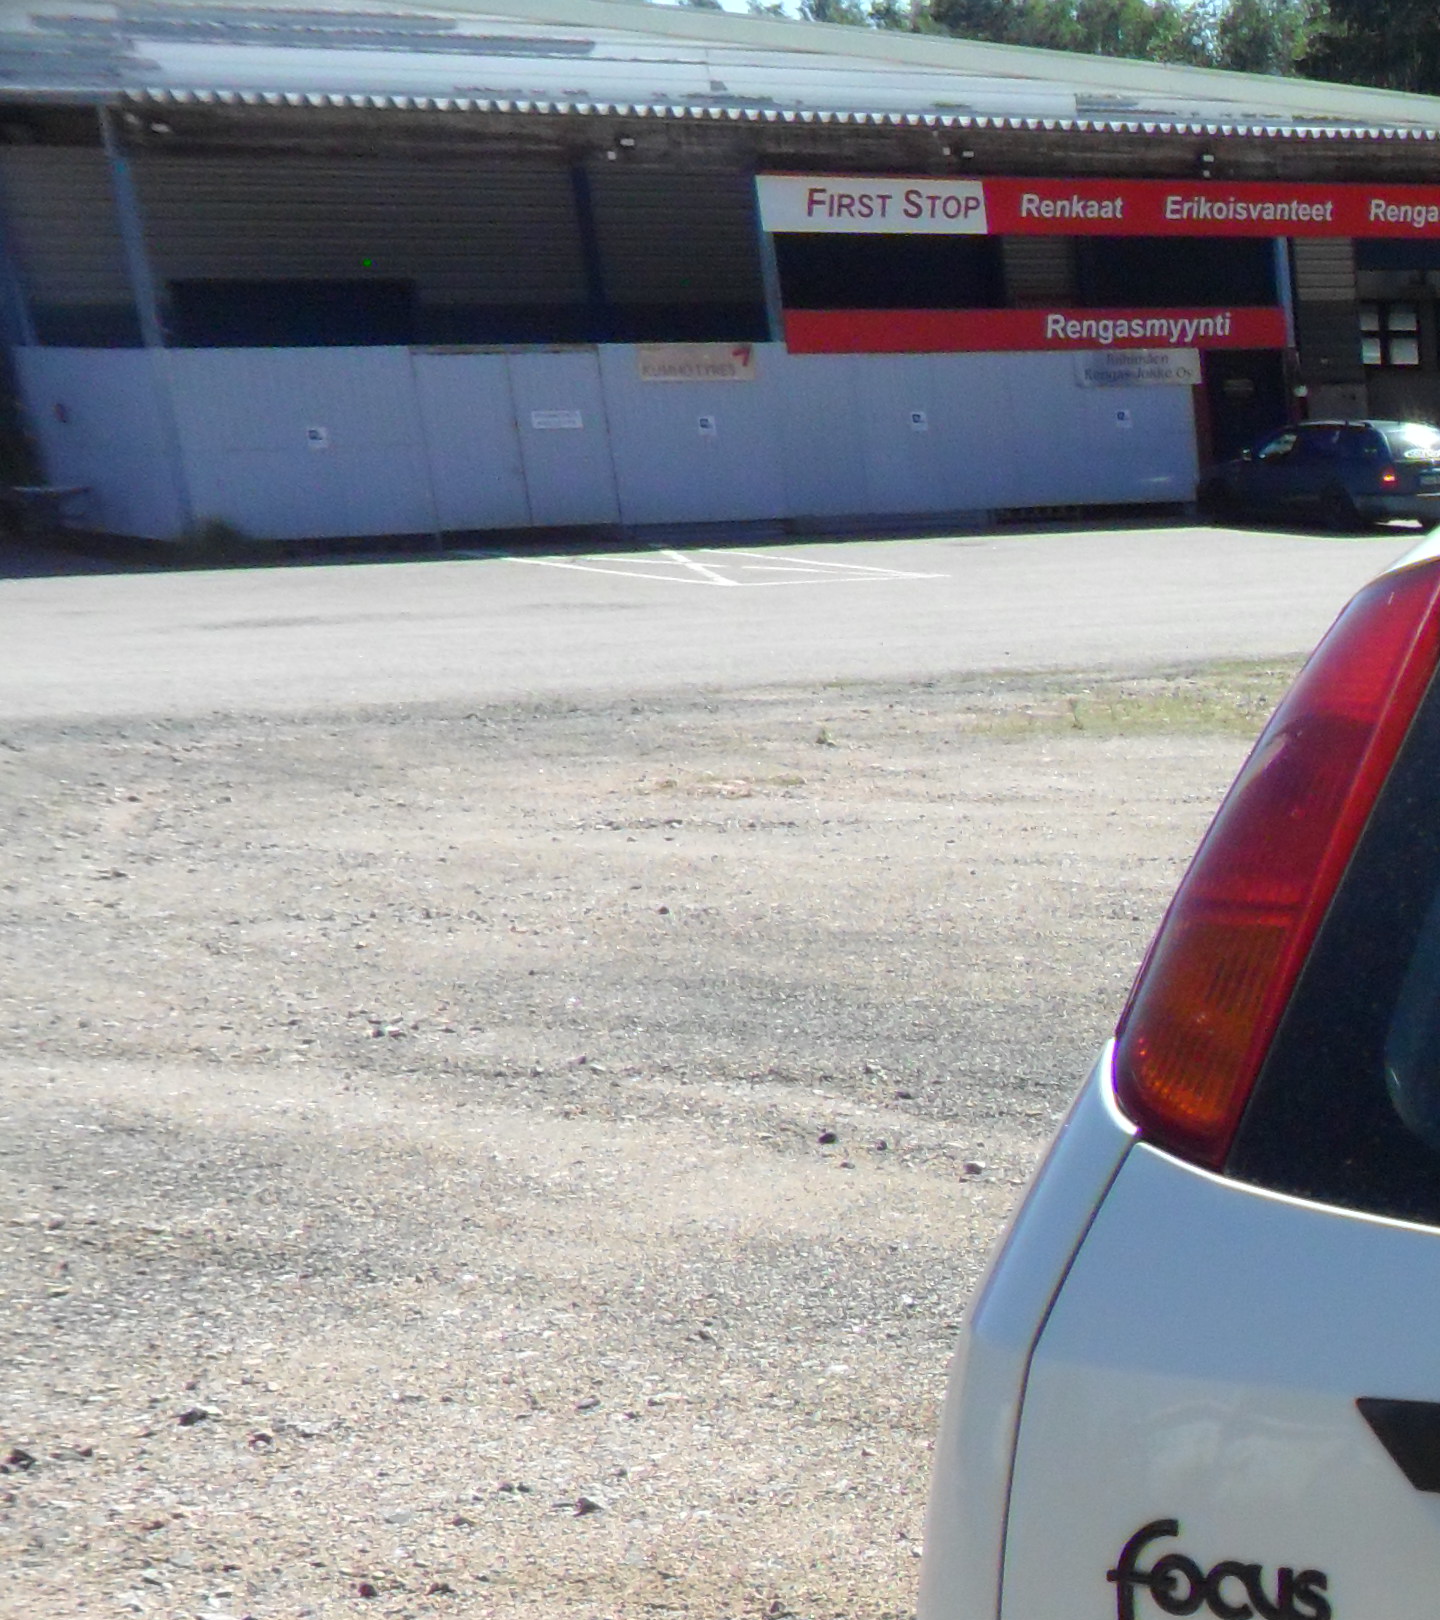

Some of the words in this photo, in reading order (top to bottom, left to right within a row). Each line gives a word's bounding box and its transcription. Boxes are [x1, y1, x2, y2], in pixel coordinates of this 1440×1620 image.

[807, 187, 893, 218] FIRST
[903, 189, 981, 219] STOP
[1020, 193, 1124, 219] Renkaat
[1165, 196, 1333, 221] Erikoisvanteet
[1046, 313, 1231, 343] Rengasmyynti
